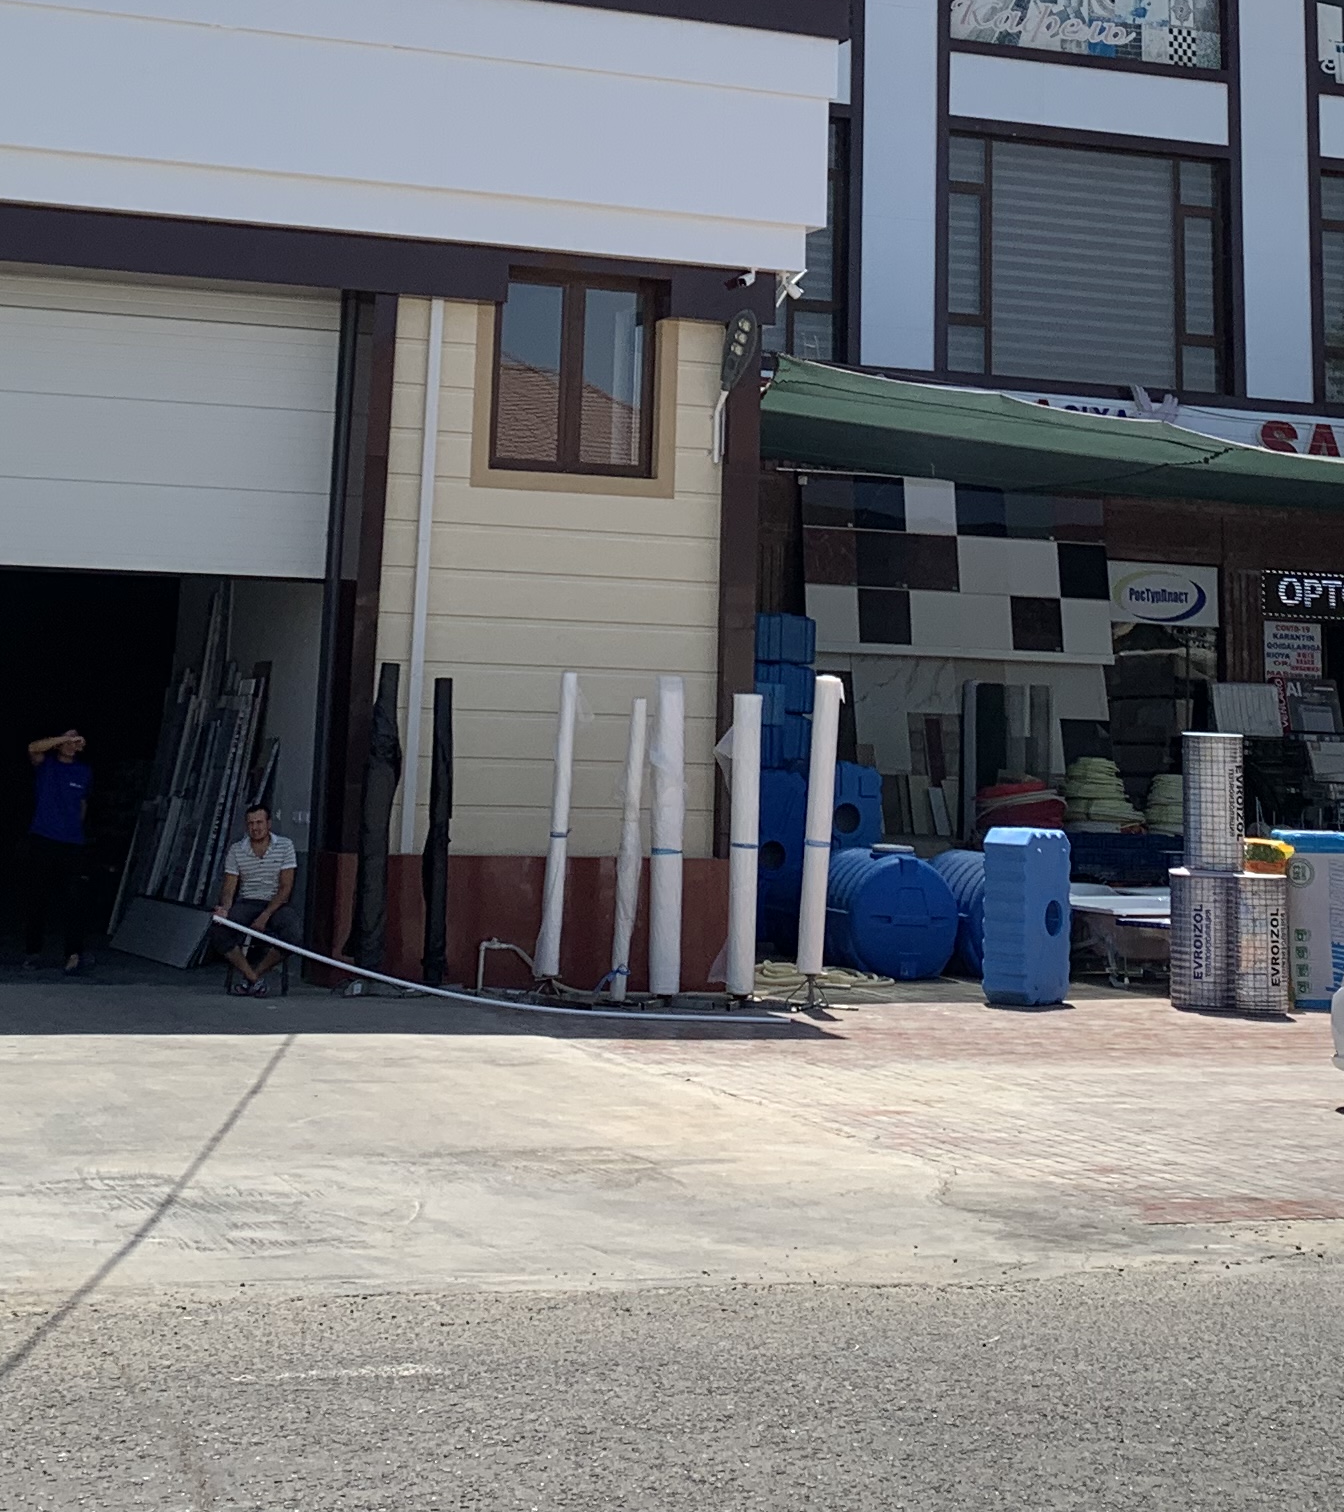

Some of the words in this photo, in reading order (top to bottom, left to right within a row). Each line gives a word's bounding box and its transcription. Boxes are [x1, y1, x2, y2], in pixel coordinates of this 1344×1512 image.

[1235, 764, 1245, 842] EVROIZOL
[1193, 903, 1203, 981] EVROIZOL
[1270, 907, 1280, 988] EVROIZOL
